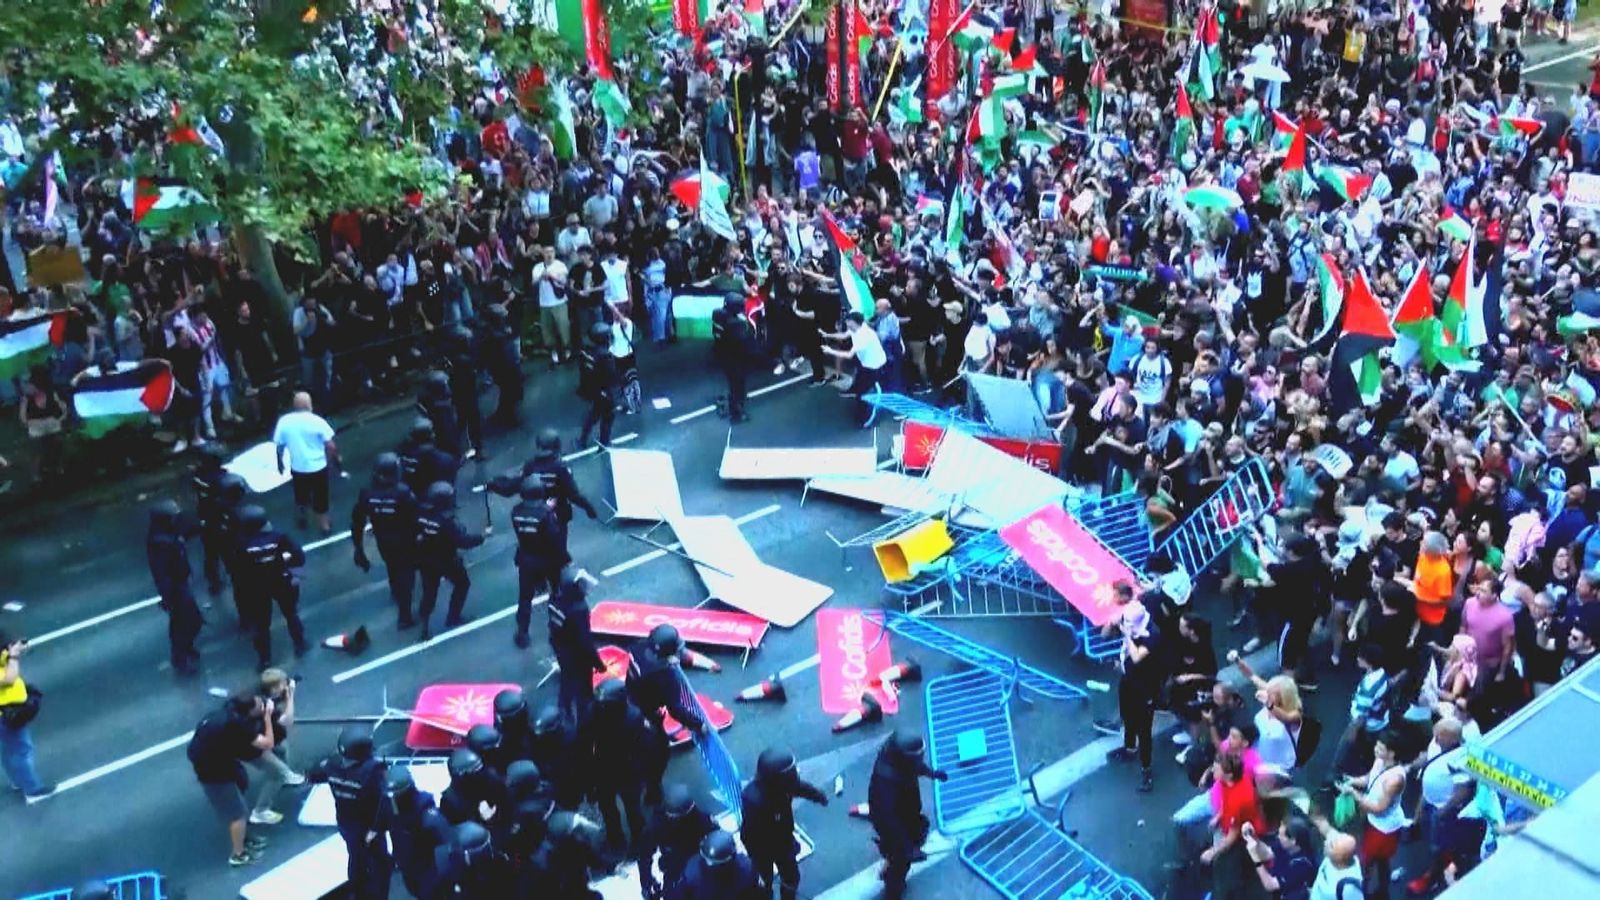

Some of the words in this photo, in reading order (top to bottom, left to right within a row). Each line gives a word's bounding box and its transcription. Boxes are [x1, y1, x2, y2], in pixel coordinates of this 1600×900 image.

[1026, 519, 1099, 586] Cofidis
[644, 614, 753, 635] Cofidis
[838, 613, 867, 680] Cofidis
